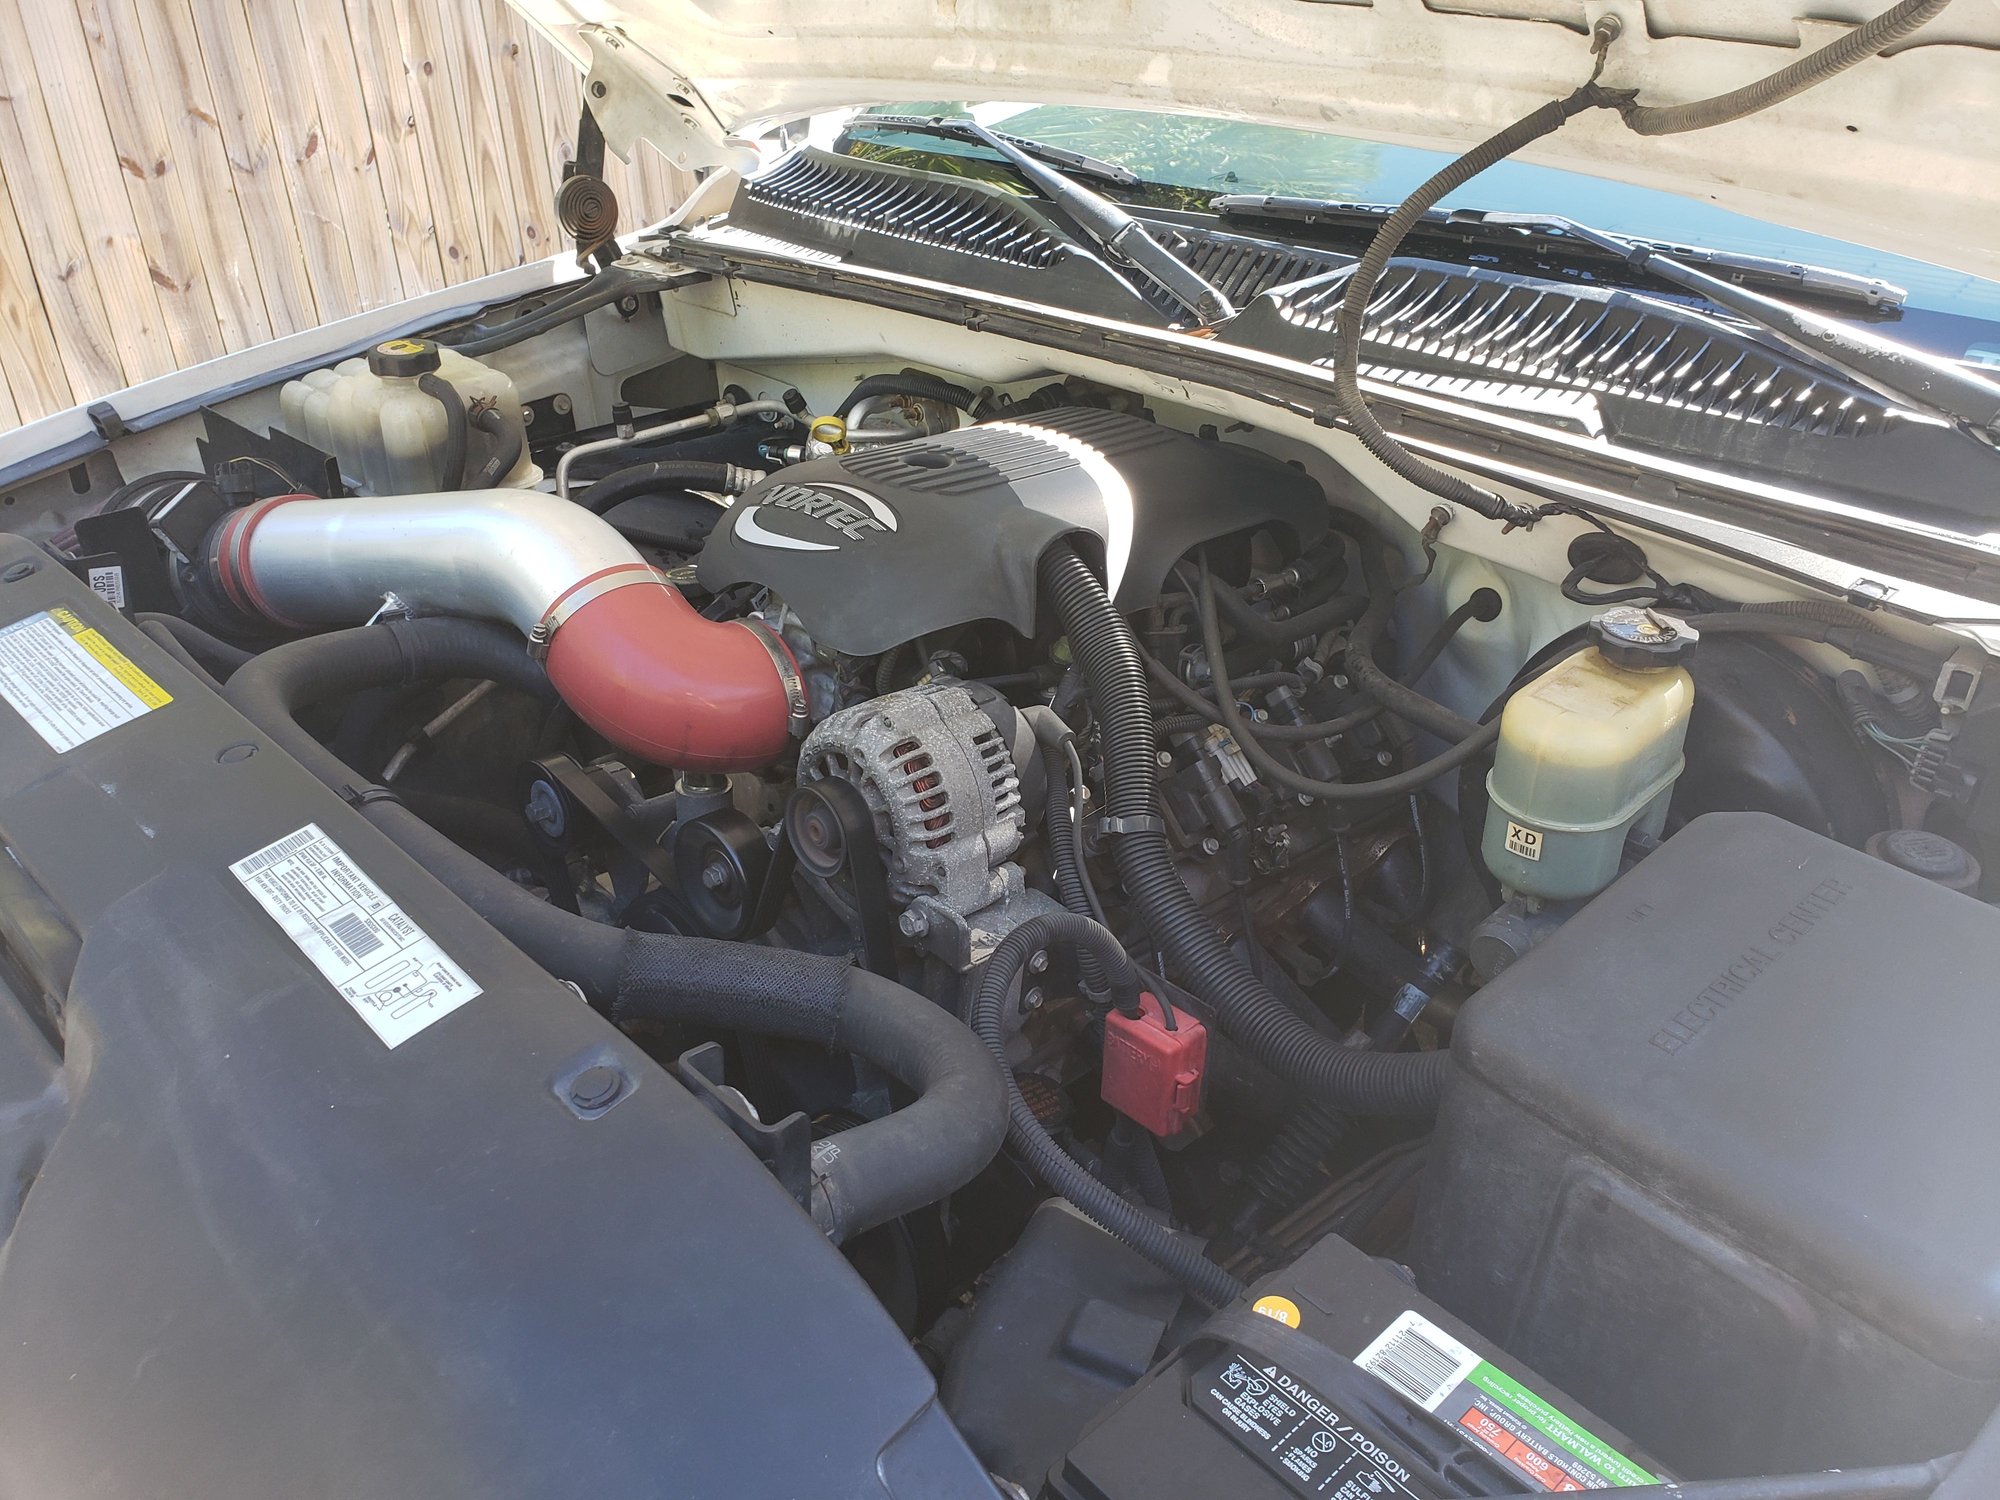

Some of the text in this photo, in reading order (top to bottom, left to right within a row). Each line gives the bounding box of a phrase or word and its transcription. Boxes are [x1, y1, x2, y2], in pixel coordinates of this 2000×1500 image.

[761, 484, 887, 541] VORTEC
[331, 869, 362, 899] INFORMATION
[332, 856, 378, 900] IMPORTANT VEHICLE
[388, 913, 415, 936] CATALYST
[1648, 877, 1853, 1057] ELECTRICAL CENTER
[821, 1147, 841, 1164] UP
[1385, 1330, 1406, 1351] 21112
[1483, 1376, 1513, 1398] recycling
[1210, 1389, 1271, 1439] CAN CAUSE BLINDNESS
[1234, 1397, 1260, 1419] GASES
[1239, 1392, 1281, 1426] EXPLOSIVE
[1262, 1399, 1283, 1416] EYES
[1269, 1394, 1296, 1416] SHIELD
[1474, 1398, 1488, 1411] INC.
[1513, 1394, 1538, 1415] proper
[1516, 1393, 1549, 1413] purchase
[1222, 1408, 1251, 1432] OR INJURY
[1278, 1376, 1339, 1425] DANGER
[1350, 1433, 1409, 1482] POISON
[1480, 1418, 1501, 1436] 750
[1490, 1409, 1516, 1431] GROUP,
[1548, 1415, 1573, 1435] battery
[1516, 1430, 1548, 1455] BATTERY
[1546, 1424, 1601, 1465] WALMART
[1574, 1434, 1589, 1445] new
[1293, 1448, 1317, 1468] SPARKS
[1304, 1446, 1318, 1457] NO
[1526, 1452, 1548, 1470] 600
[1282, 1458, 1309, 1481] SMOKING
[1288, 1453, 1312, 1473] FLAMES
[1548, 1454, 1586, 1482] CONTROLS
[1604, 1463, 1615, 1474] to
[1572, 1462, 1607, 1488] WI 53209
[1622, 1466, 1643, 1483] credit
